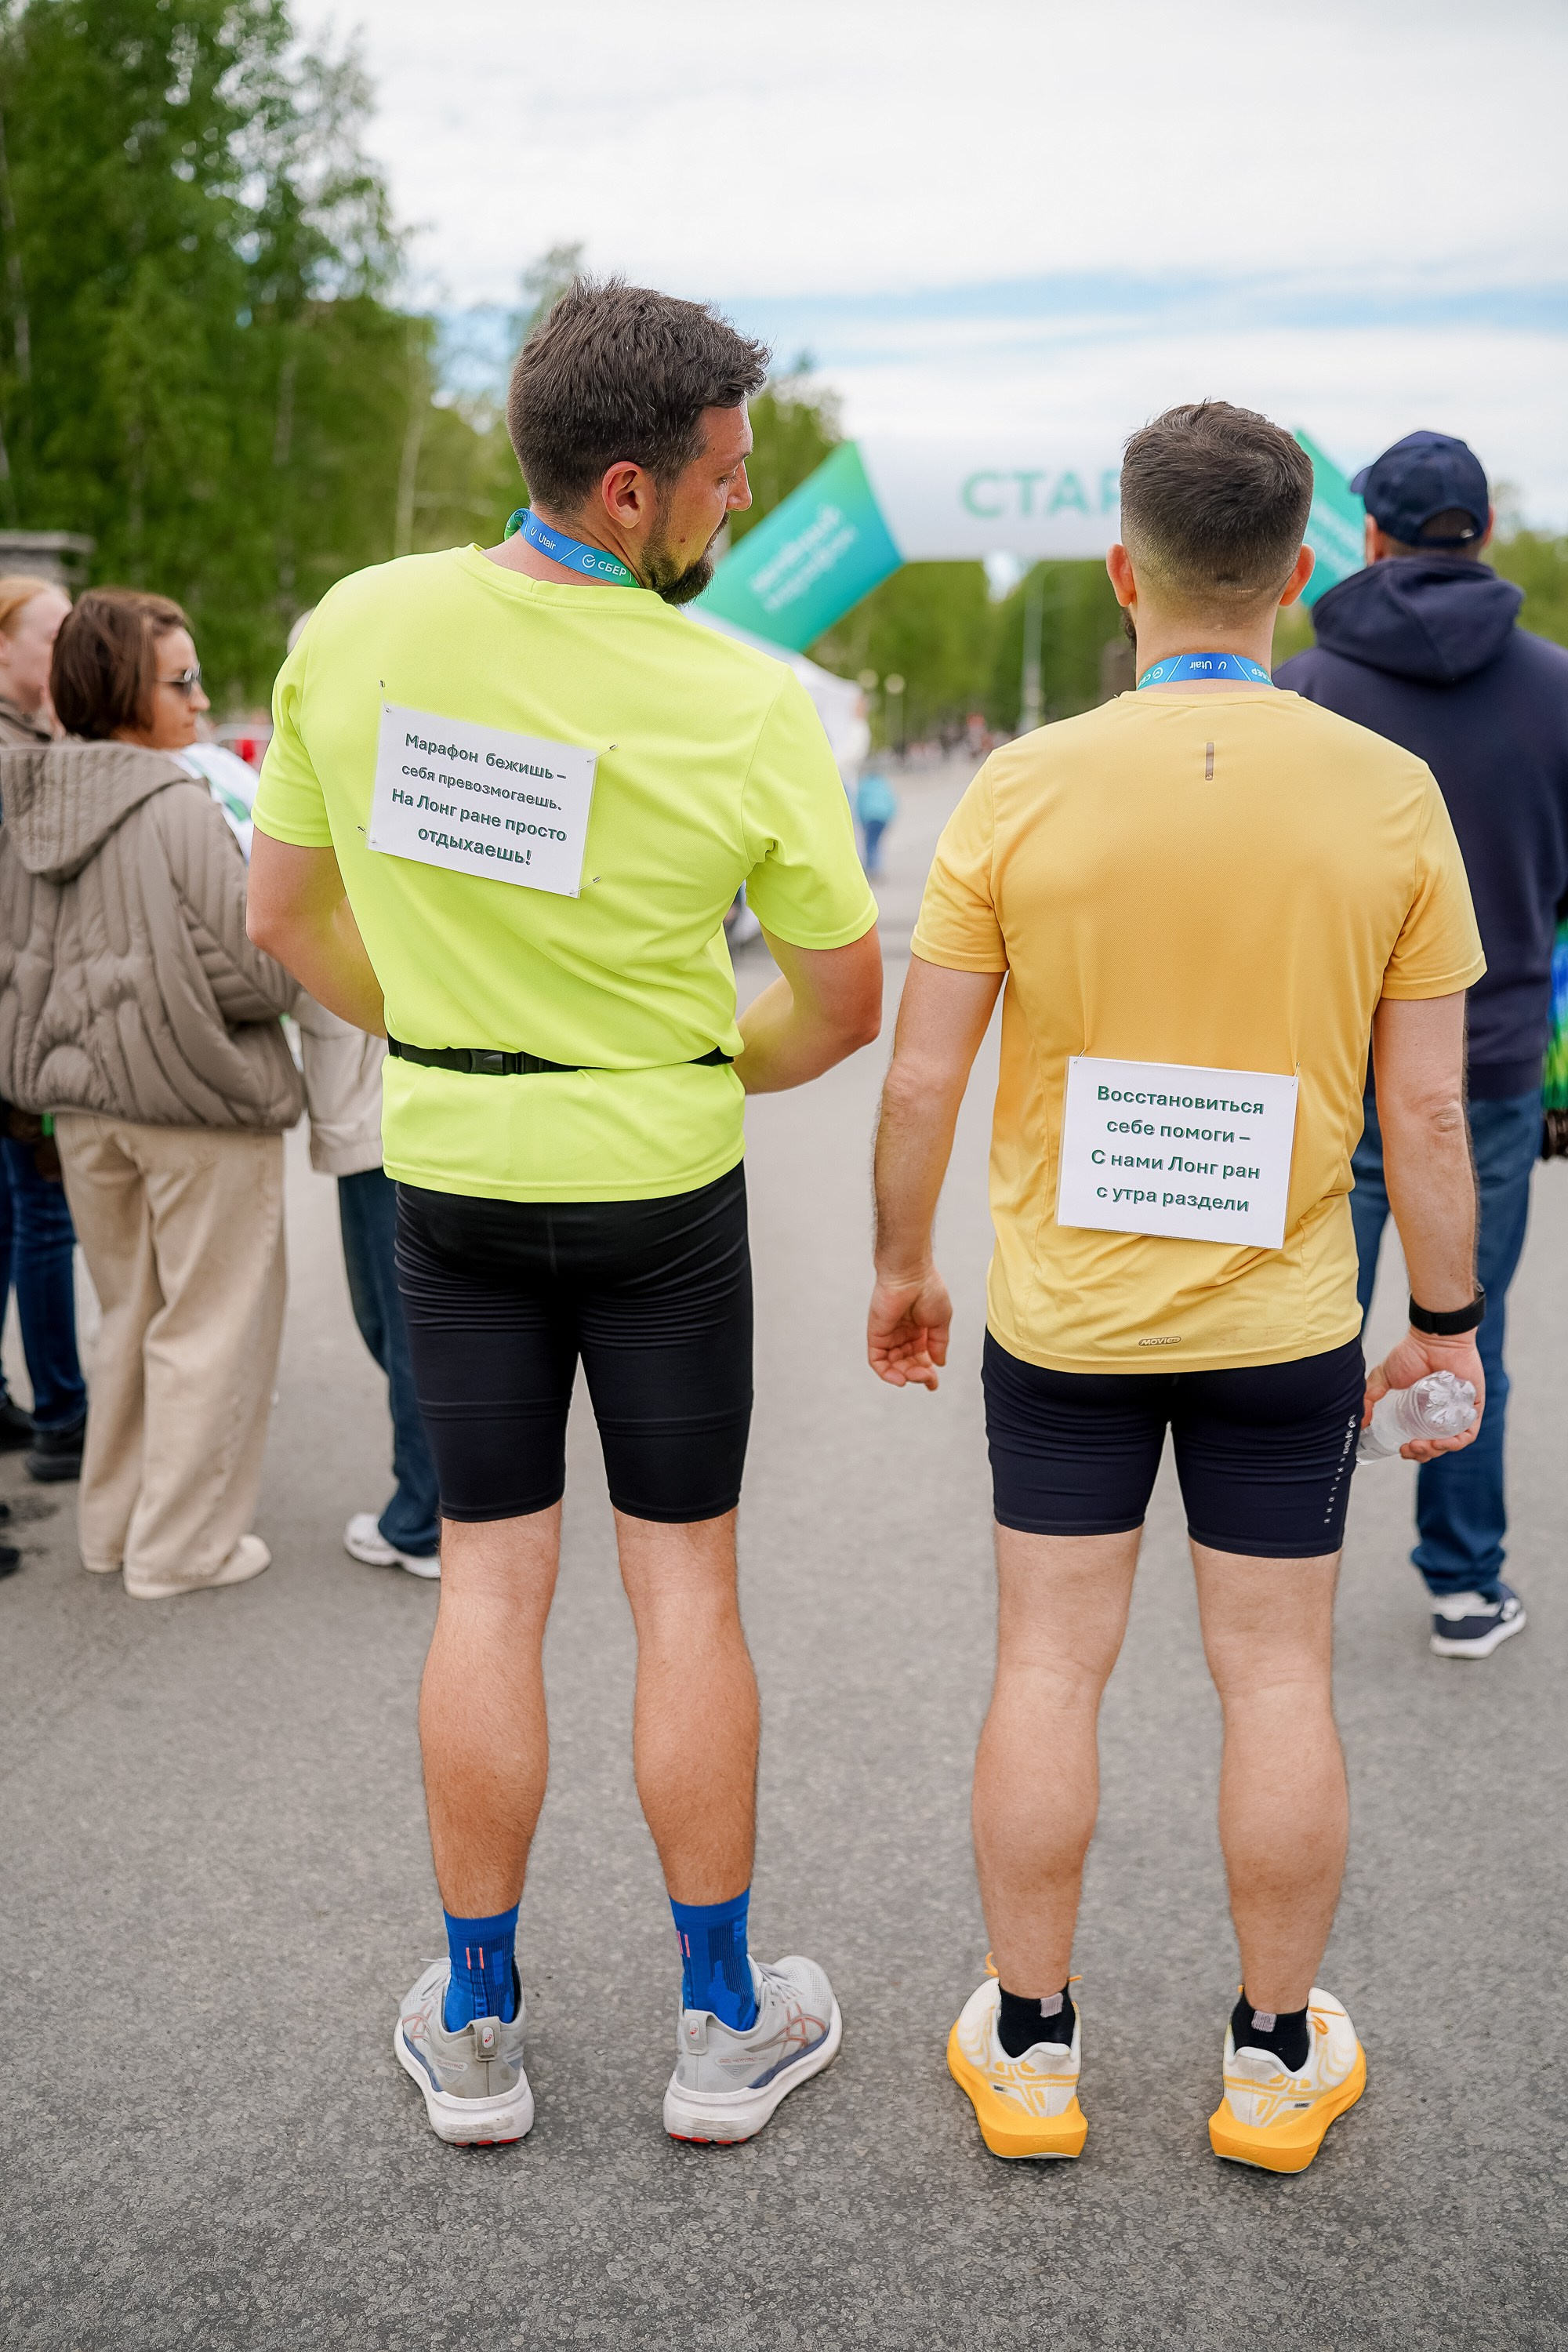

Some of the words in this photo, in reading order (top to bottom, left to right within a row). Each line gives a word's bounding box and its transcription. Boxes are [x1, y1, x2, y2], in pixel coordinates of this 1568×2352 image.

[961, 469, 1121, 517] СТАР
[539, 534, 556, 550] Utair
[598, 561, 626, 576] СБЕР
[1189, 660, 1212, 670] Utair
[406, 733, 478, 763] Марафон
[486, 753, 554, 779] бежишь
[402, 766, 435, 781] себя
[439, 774, 561, 810] превозмогаешь.
[392, 789, 413, 806] На
[417, 795, 457, 816] Лонг
[460, 809, 501, 827] ране
[506, 819, 567, 841] просто
[419, 829, 532, 865] отдыхаешь!
[1098, 1086, 1264, 1114] Восстановиться
[1107, 1120, 1155, 1135] себе
[1160, 1126, 1235, 1142] помоги
[1091, 1150, 1105, 1164] С
[1112, 1155, 1163, 1170] нами
[1168, 1156, 1218, 1174] Лонг
[1223, 1165, 1260, 1179] ран
[1097, 1187, 1108, 1198] с
[1112, 1189, 1156, 1204] утра
[1163, 1193, 1249, 1211] раздели
